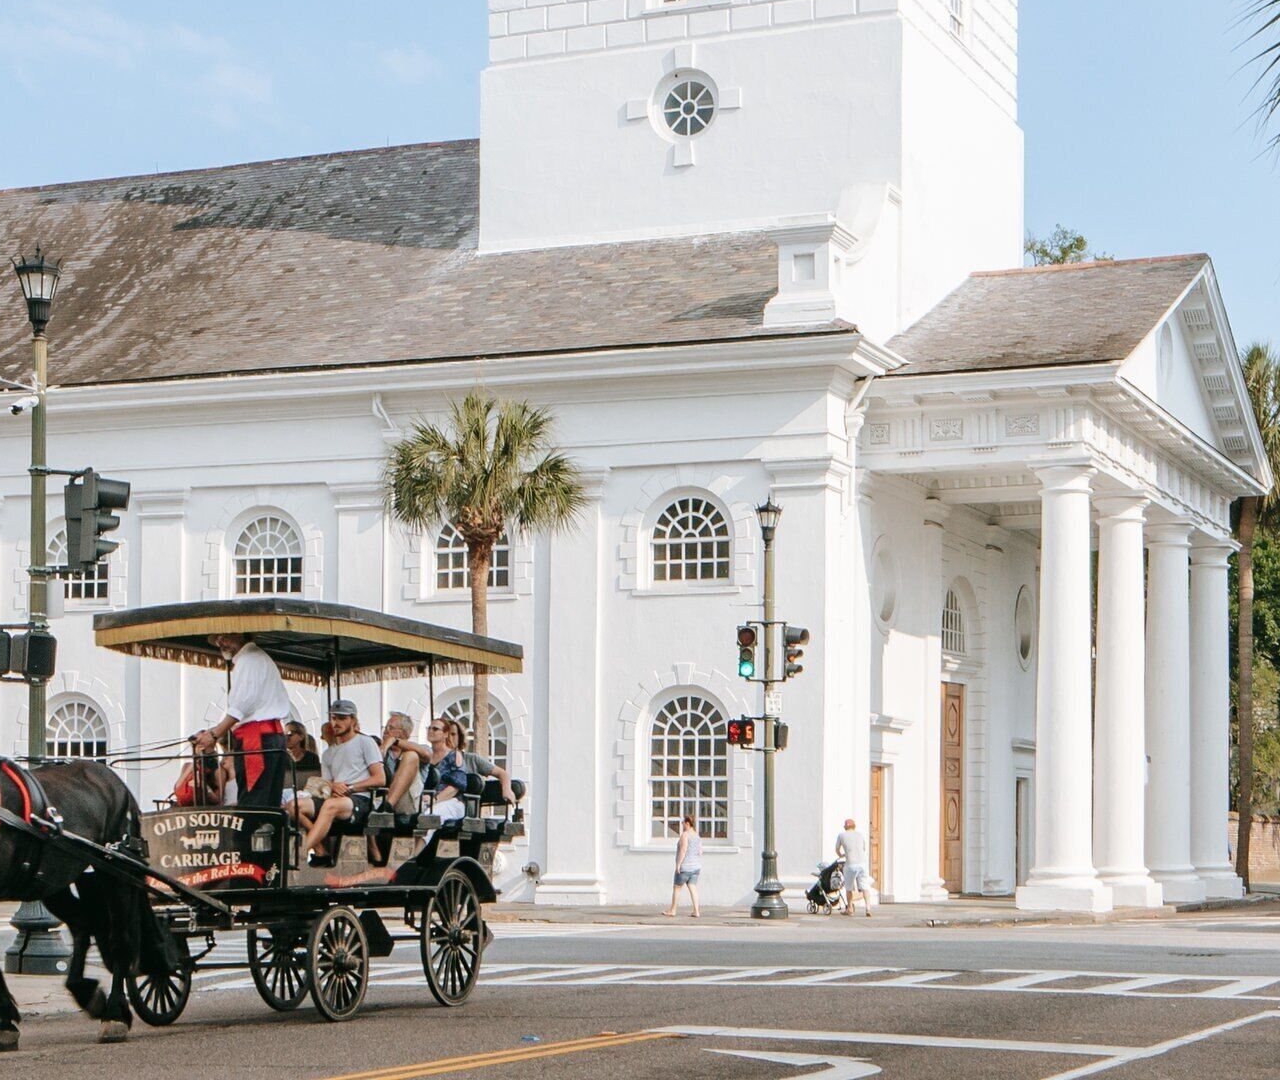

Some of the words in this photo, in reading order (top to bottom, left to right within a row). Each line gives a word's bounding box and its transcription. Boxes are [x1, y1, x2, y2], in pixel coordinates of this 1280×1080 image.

[153, 816, 187, 836] OLD
[189, 813, 245, 832] SOUTH
[161, 851, 242, 868] CARRIAGE
[192, 872, 208, 884] the
[211, 866, 229, 880] Red
[230, 864, 255, 875] Sash
